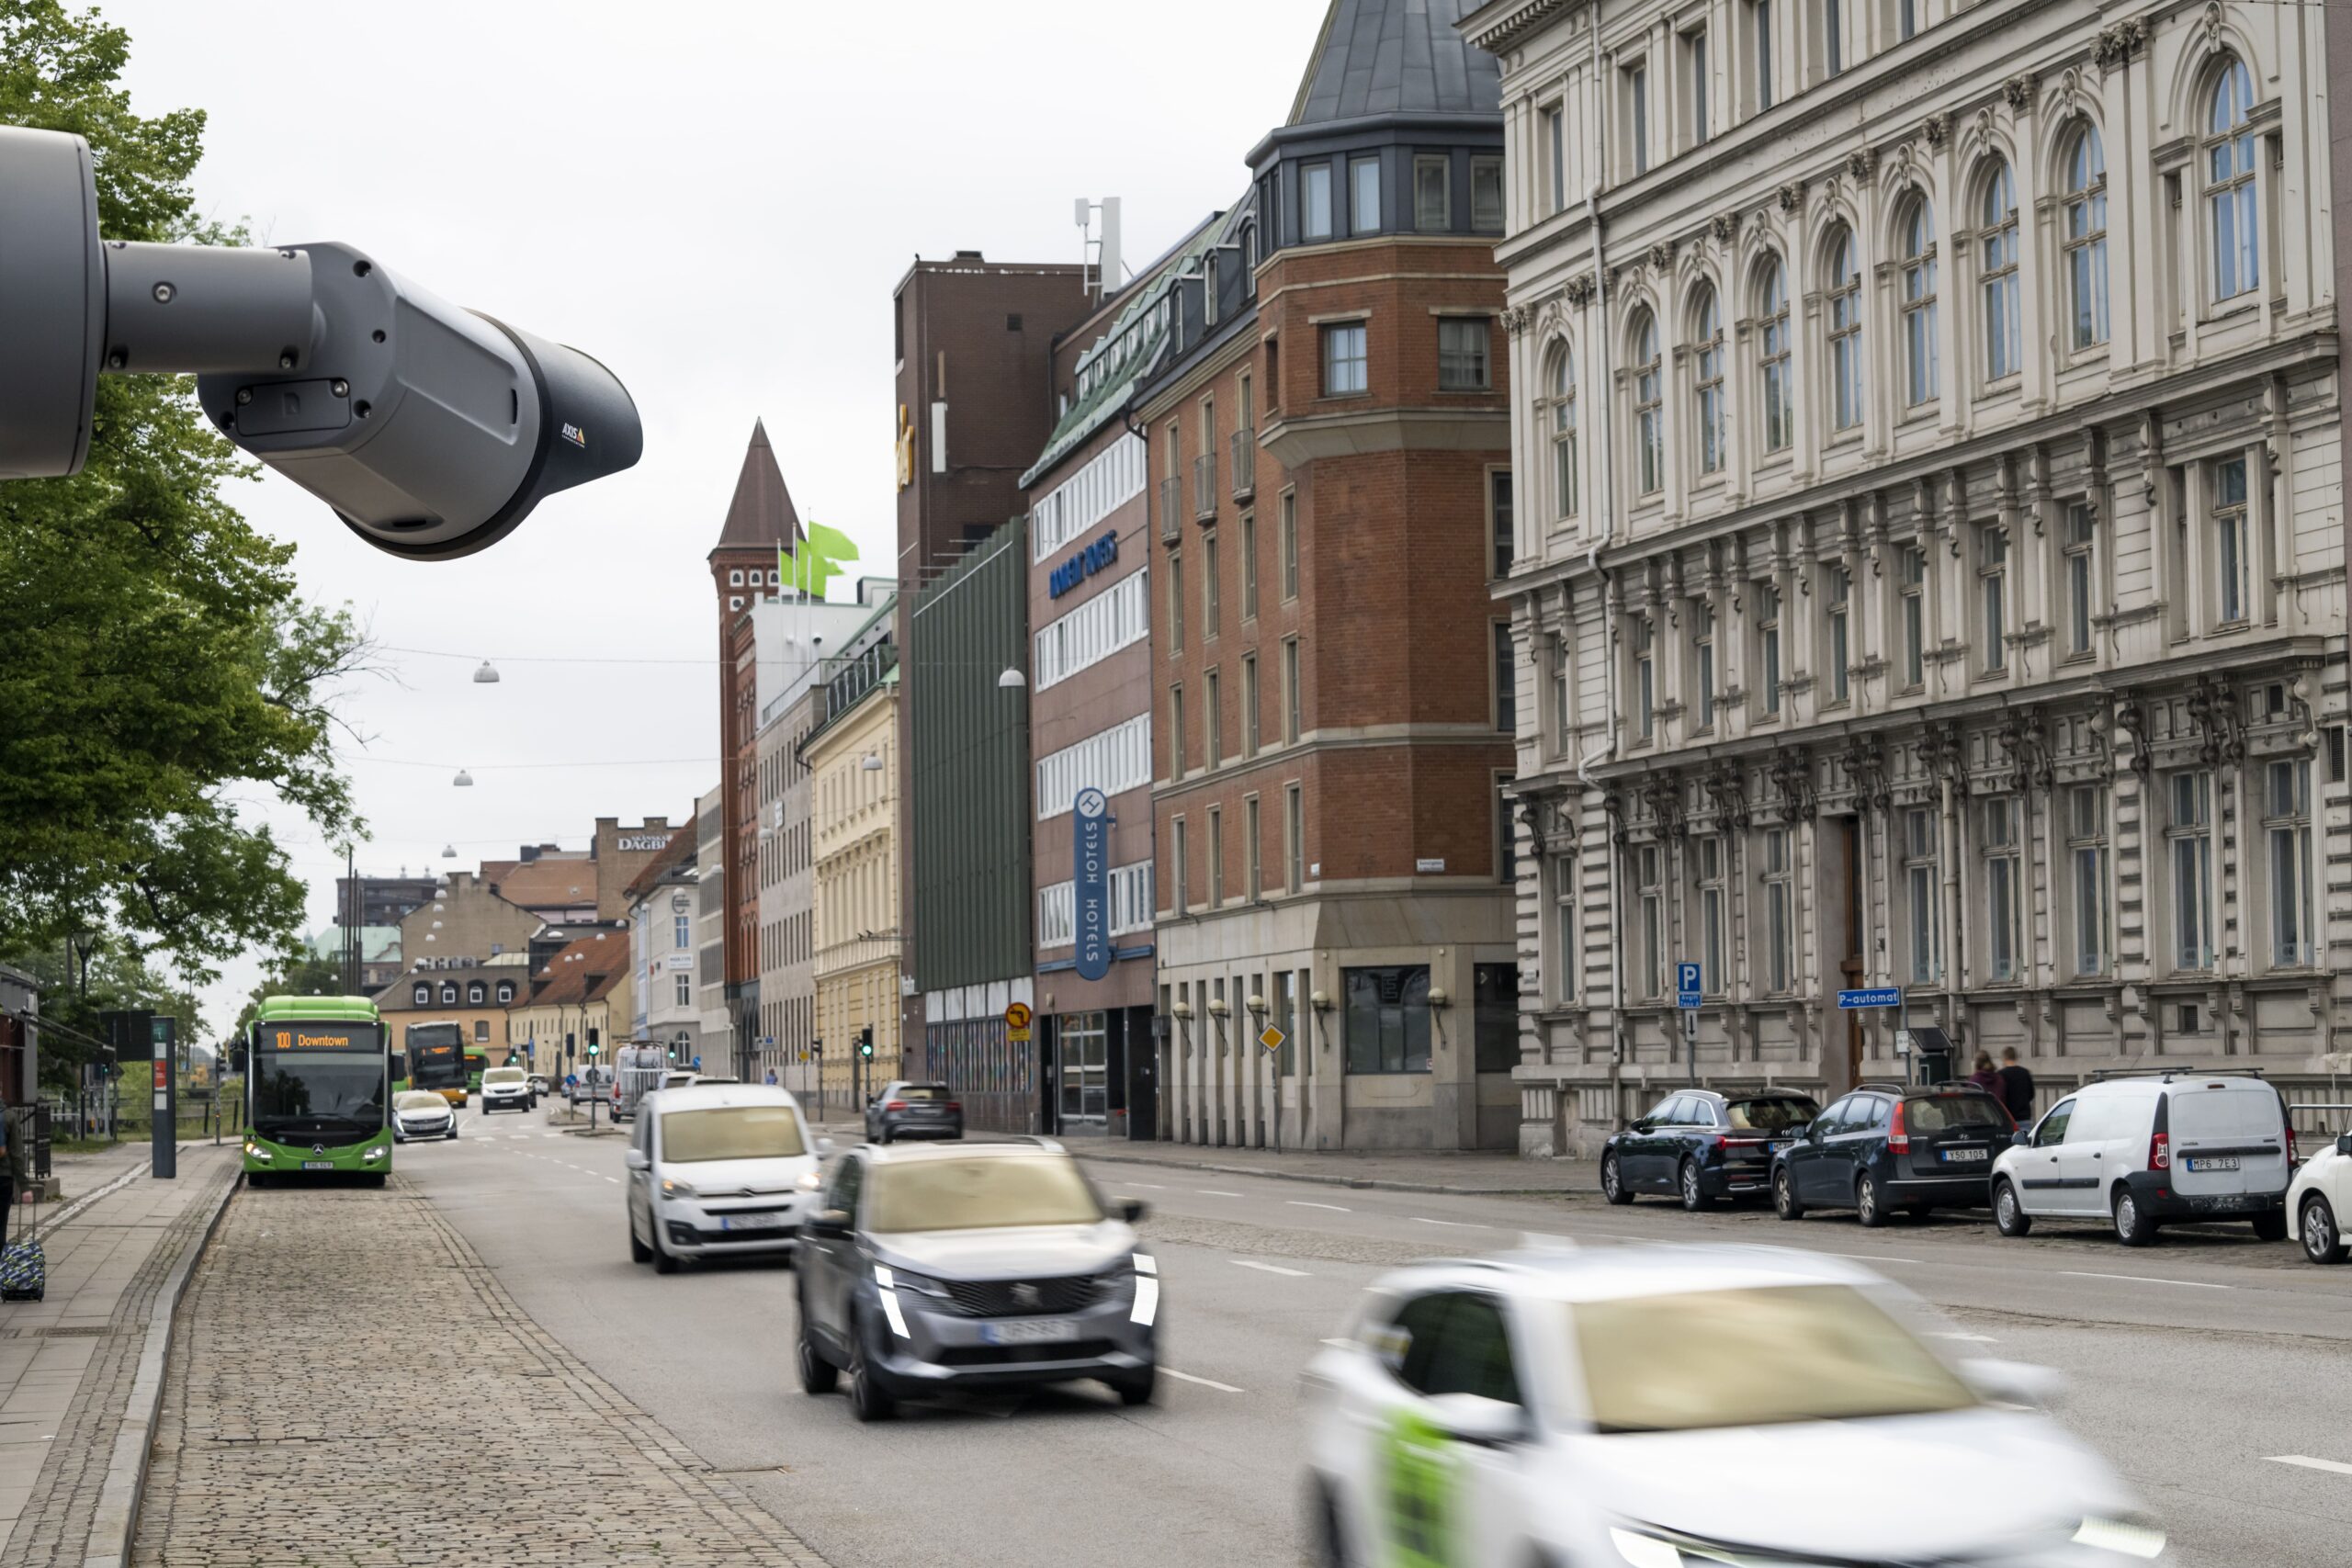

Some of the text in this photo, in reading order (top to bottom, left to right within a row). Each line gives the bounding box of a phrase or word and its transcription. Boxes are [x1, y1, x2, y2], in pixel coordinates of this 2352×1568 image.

[562, 423, 578, 439] AXIS
[1085, 821, 1098, 884] HOTELS
[1086, 898, 1099, 962] HOTELS
[1683, 965, 1697, 990] P
[1839, 992, 1897, 1004] P-automat
[277, 1032, 349, 1048] 100 Downtown
